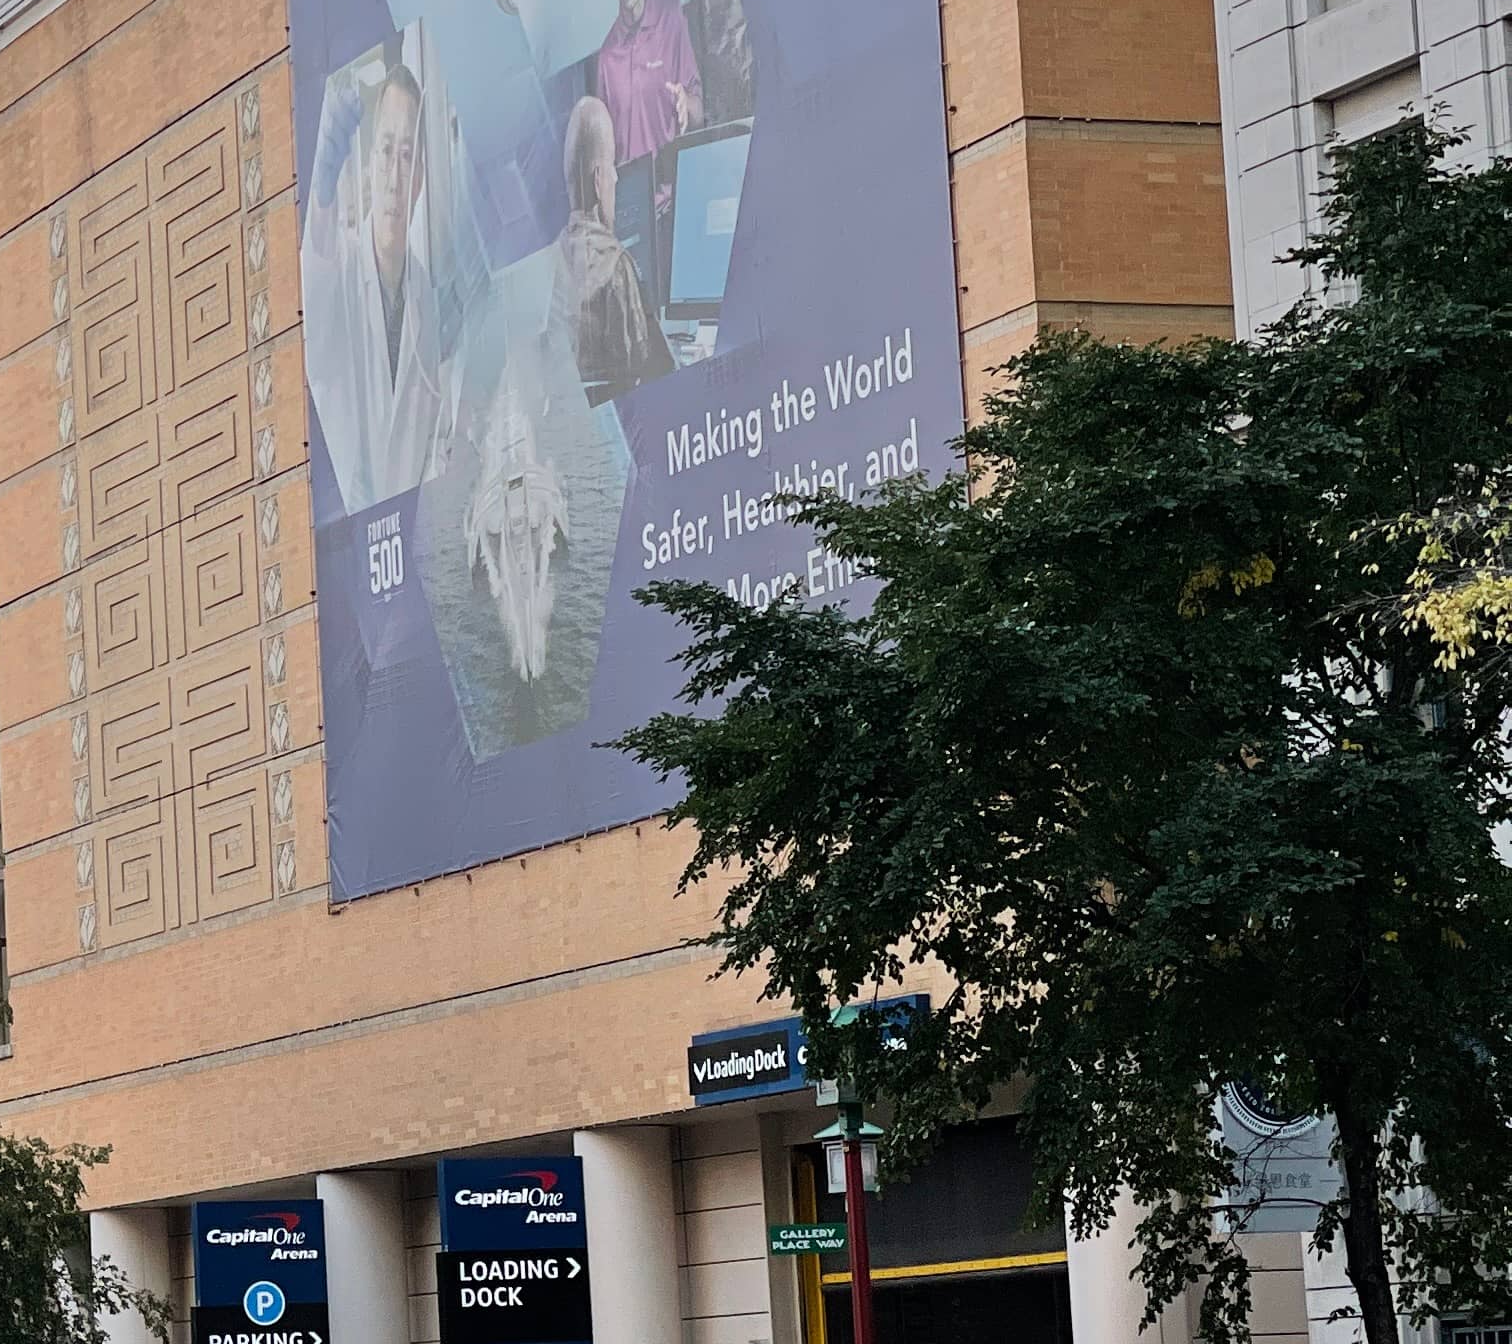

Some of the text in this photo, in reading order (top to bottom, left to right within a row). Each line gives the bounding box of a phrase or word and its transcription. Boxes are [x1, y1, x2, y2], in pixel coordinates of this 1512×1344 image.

[666, 327, 914, 477] Making the World
[641, 417, 920, 570] Safer, Healthier, and
[367, 511, 400, 543] FORTUNE
[368, 535, 403, 594] 500
[706, 1050, 755, 1080] Loading
[754, 1043, 786, 1072] Dock
[525, 1209, 578, 1225] Arena
[772, 1239, 845, 1250] PLACE WAY
[779, 1229, 836, 1239] GALLERY
[270, 1247, 319, 1261] Arena
[458, 1258, 559, 1283] LOADING
[255, 1292, 275, 1317] P
[460, 1286, 524, 1309] DOCK
